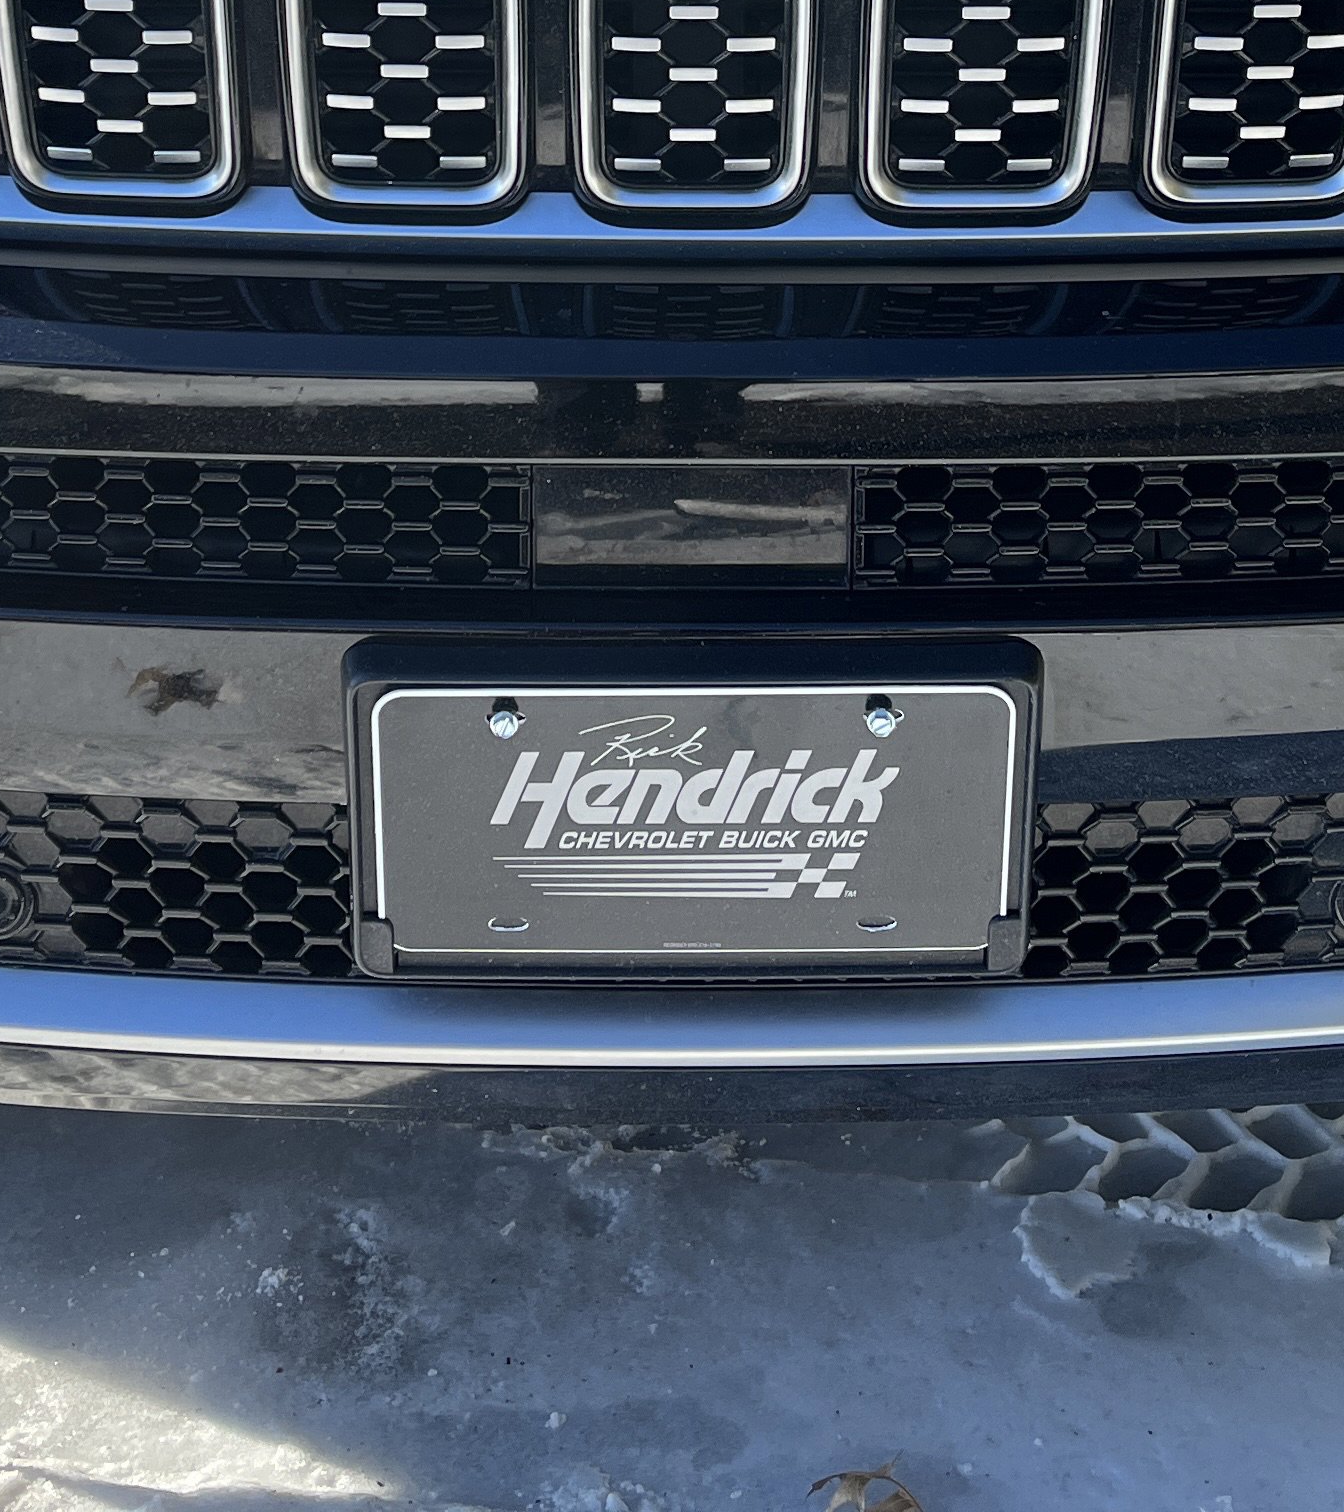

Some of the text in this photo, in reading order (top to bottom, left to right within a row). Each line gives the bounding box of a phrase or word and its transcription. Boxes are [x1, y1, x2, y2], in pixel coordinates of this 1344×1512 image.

[578, 714, 708, 768] Rick
[489, 749, 900, 849] Hendrick
[558, 829, 868, 850] CHEVROLET BUICK GMC
